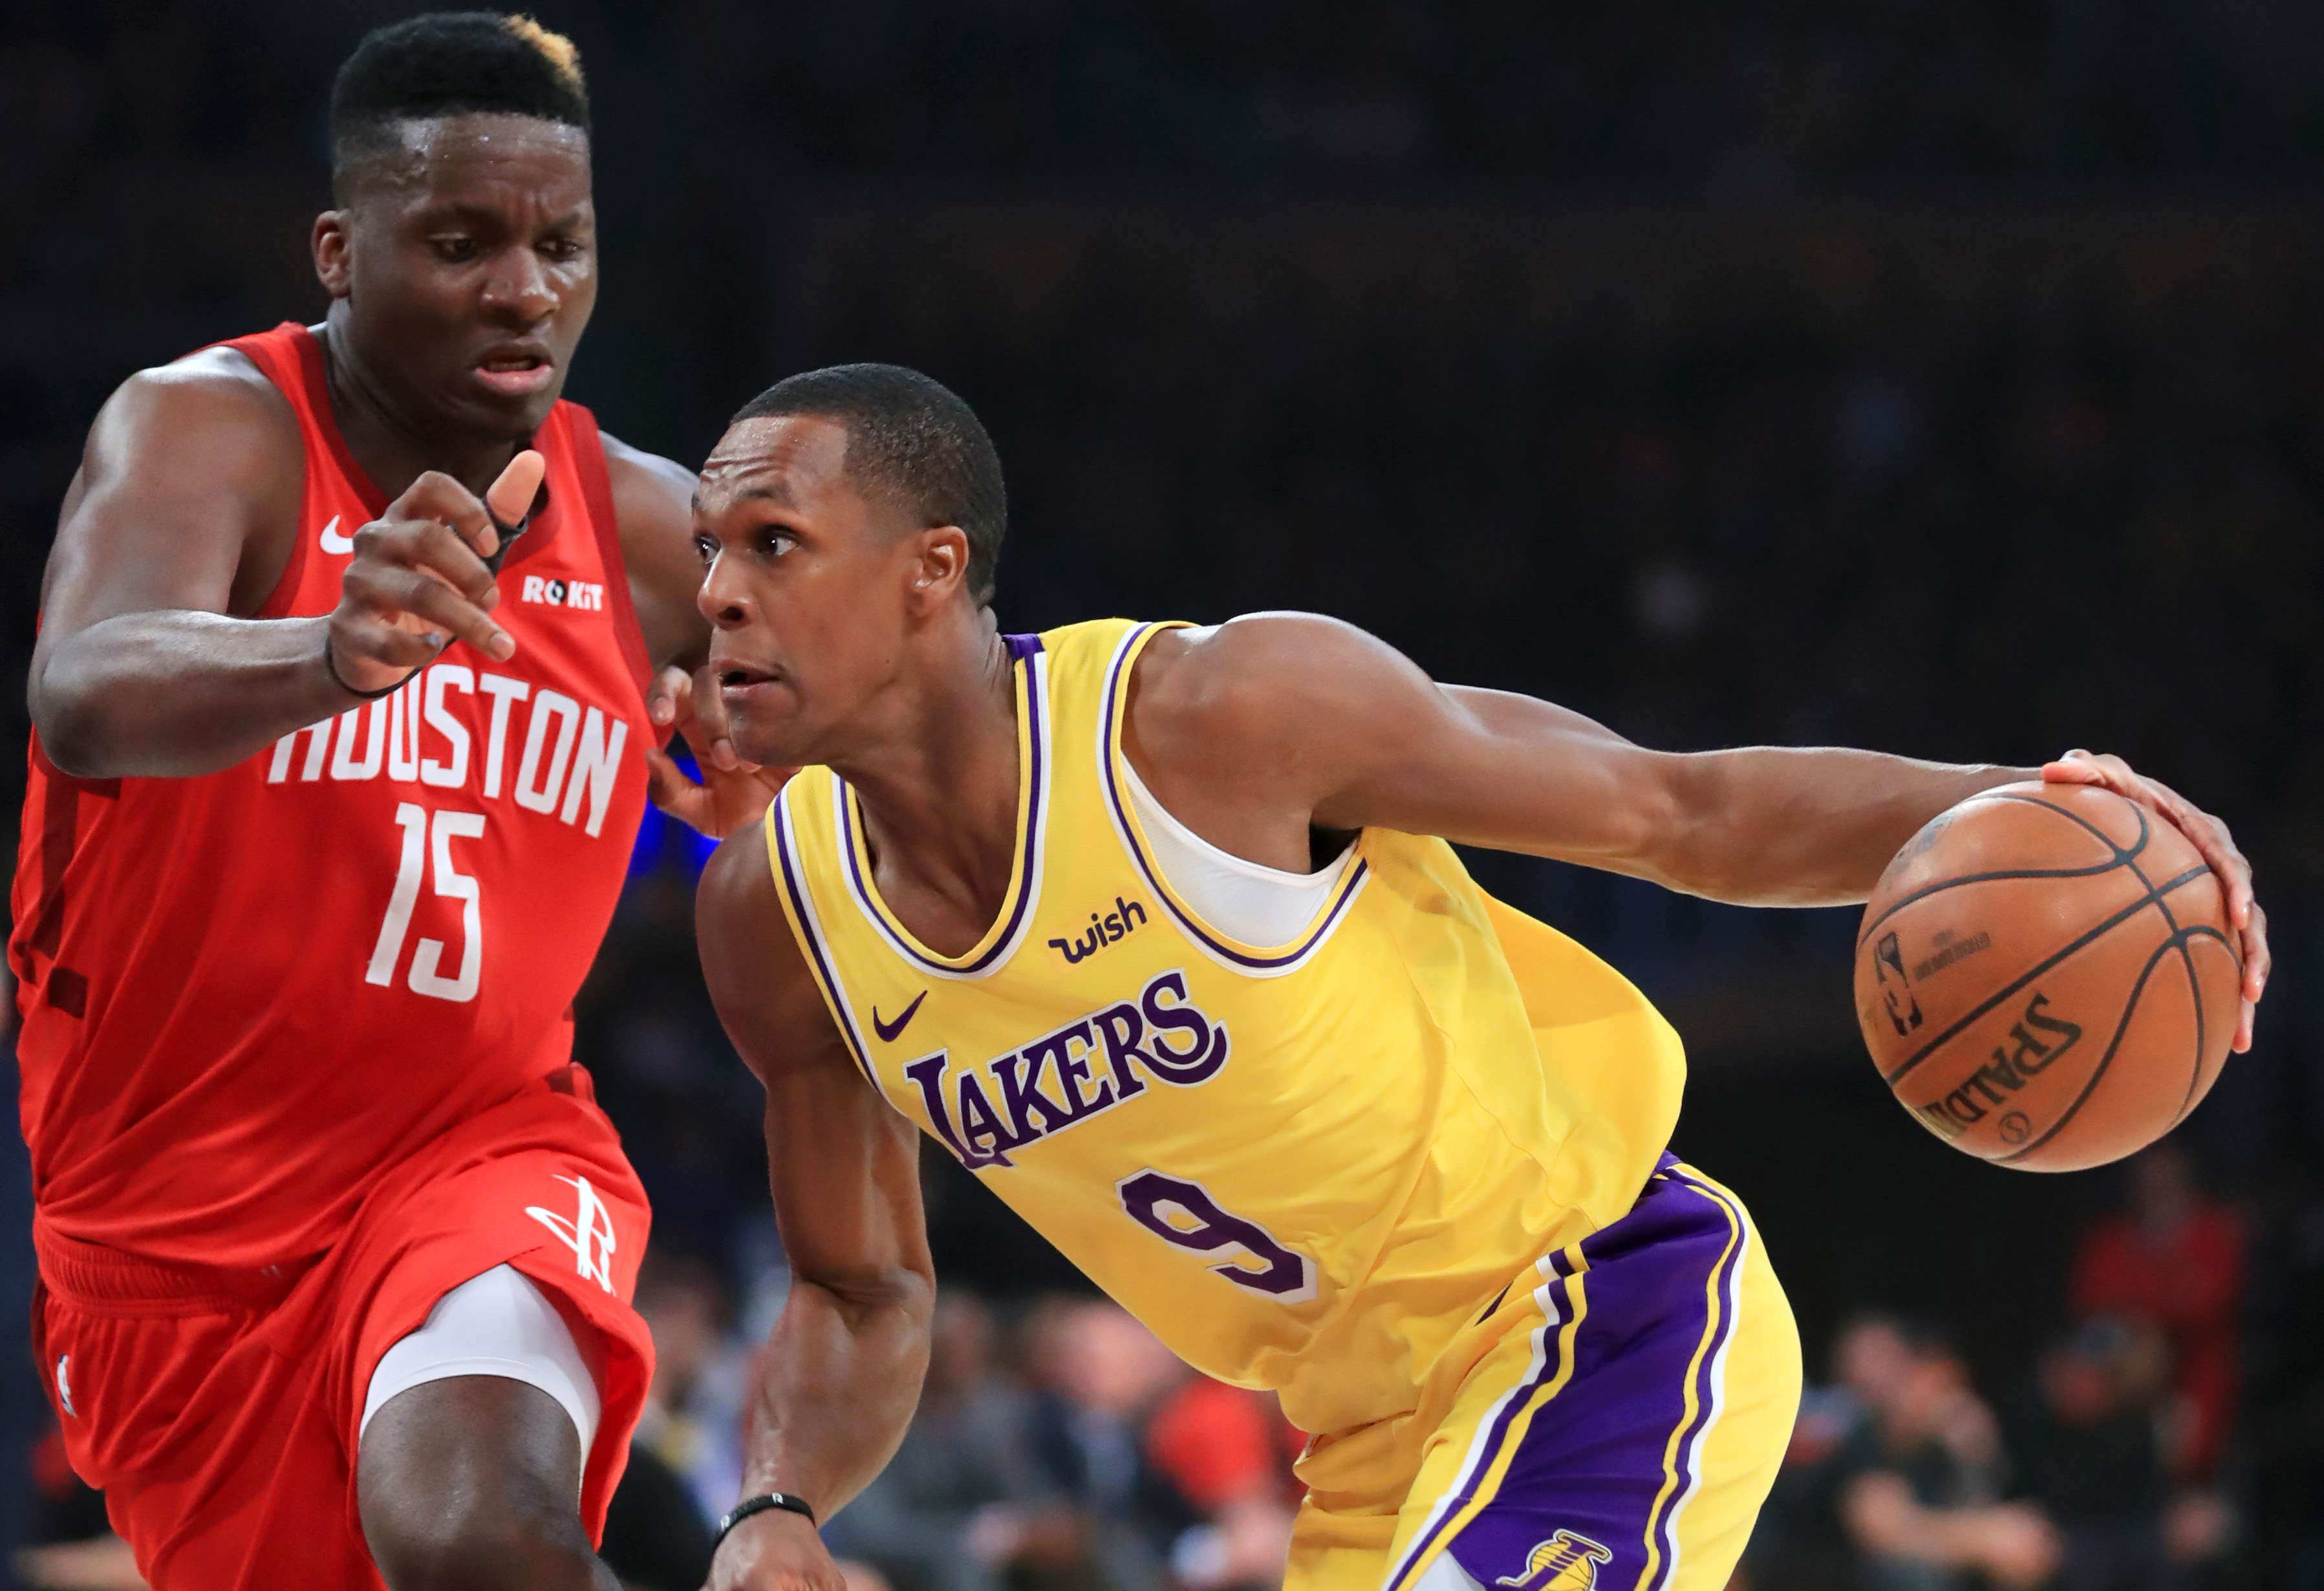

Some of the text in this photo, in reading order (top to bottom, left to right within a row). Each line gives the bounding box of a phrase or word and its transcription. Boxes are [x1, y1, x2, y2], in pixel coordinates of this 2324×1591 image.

[365, 802, 486, 1003] 15
[1048, 896, 1147, 964] wish
[903, 967, 1231, 1172] LAKERS
[1918, 991, 2082, 1138] SPALDI
[1115, 1168, 1318, 1305] 9
